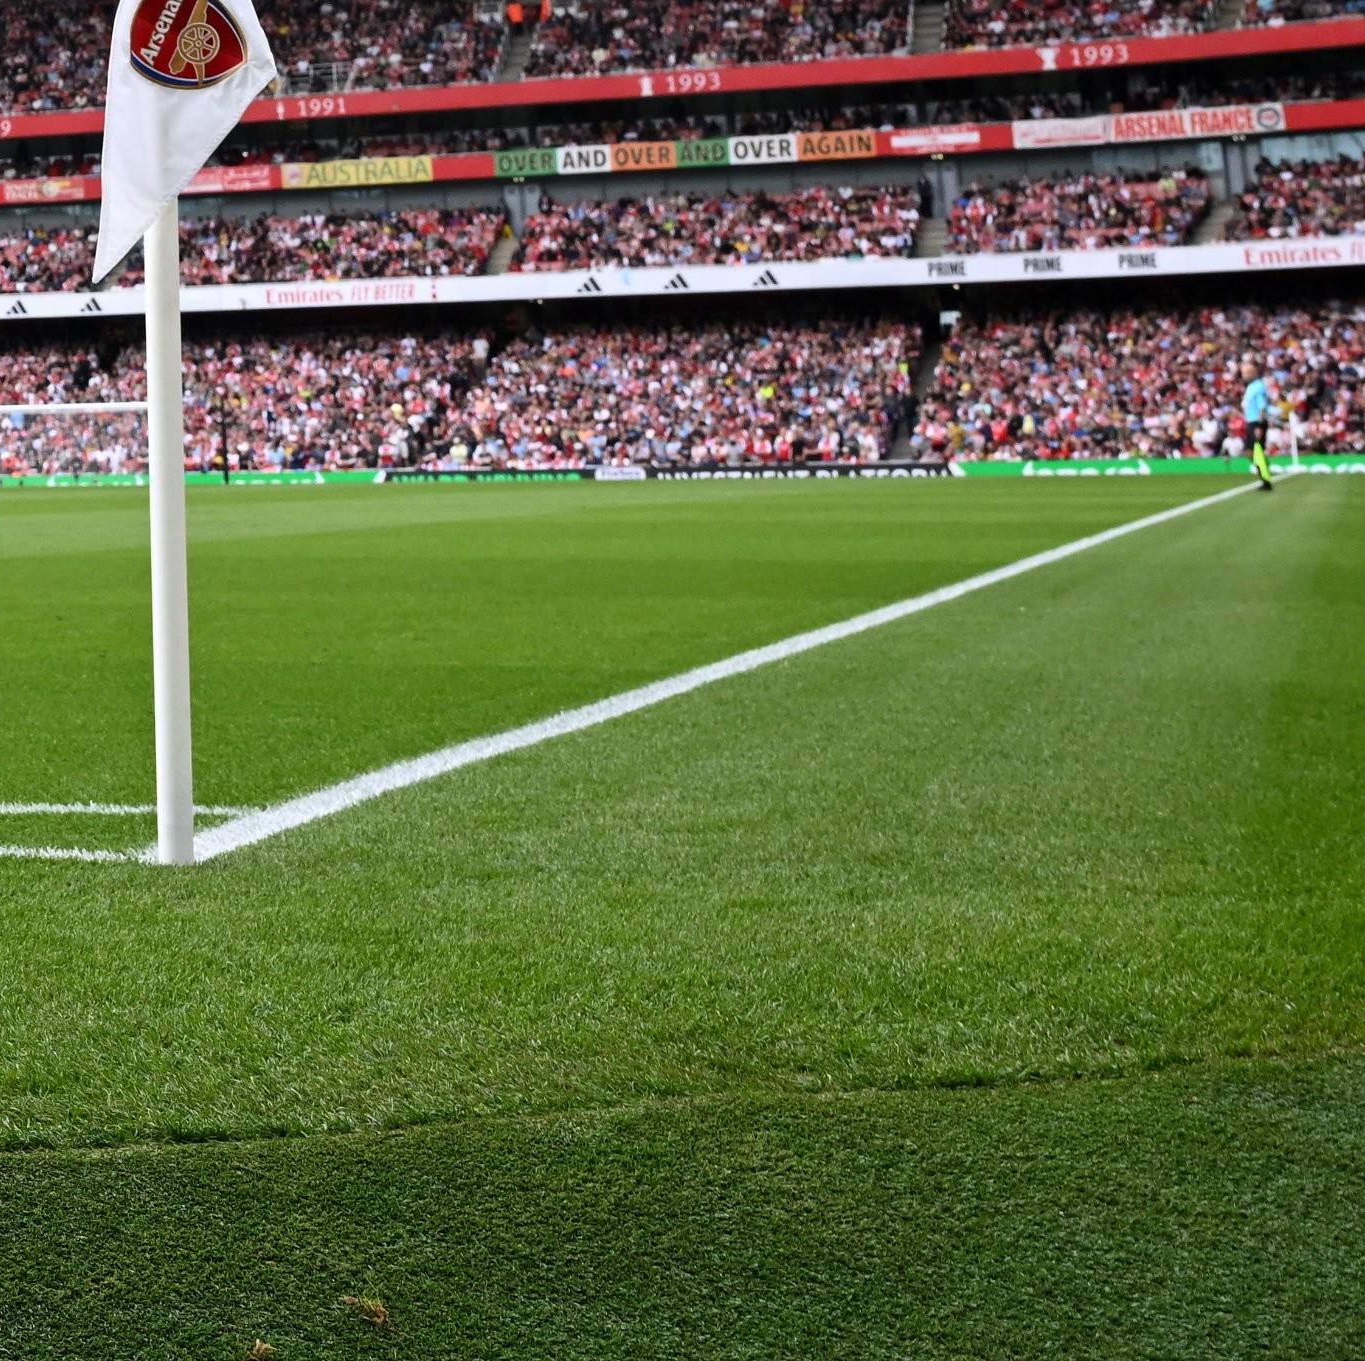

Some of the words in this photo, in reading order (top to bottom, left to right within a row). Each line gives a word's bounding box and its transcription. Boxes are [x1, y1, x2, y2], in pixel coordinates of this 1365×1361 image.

[1070, 43, 1129, 67] 1993
[665, 71, 721, 93] 1993
[297, 97, 347, 119] 1991
[1113, 111, 1185, 139] ARSENAL
[1190, 107, 1254, 133] FRANCE
[499, 153, 553, 172] OVER
[563, 149, 606, 169] AND
[613, 146, 670, 166] OVER
[680, 142, 727, 162] AND
[734, 140, 791, 159] OVER
[802, 135, 872, 155] AGAIN
[305, 158, 430, 185] AUSTRALIA
[1243, 243, 1342, 265] Emirates
[265, 288, 343, 305] Emirates
